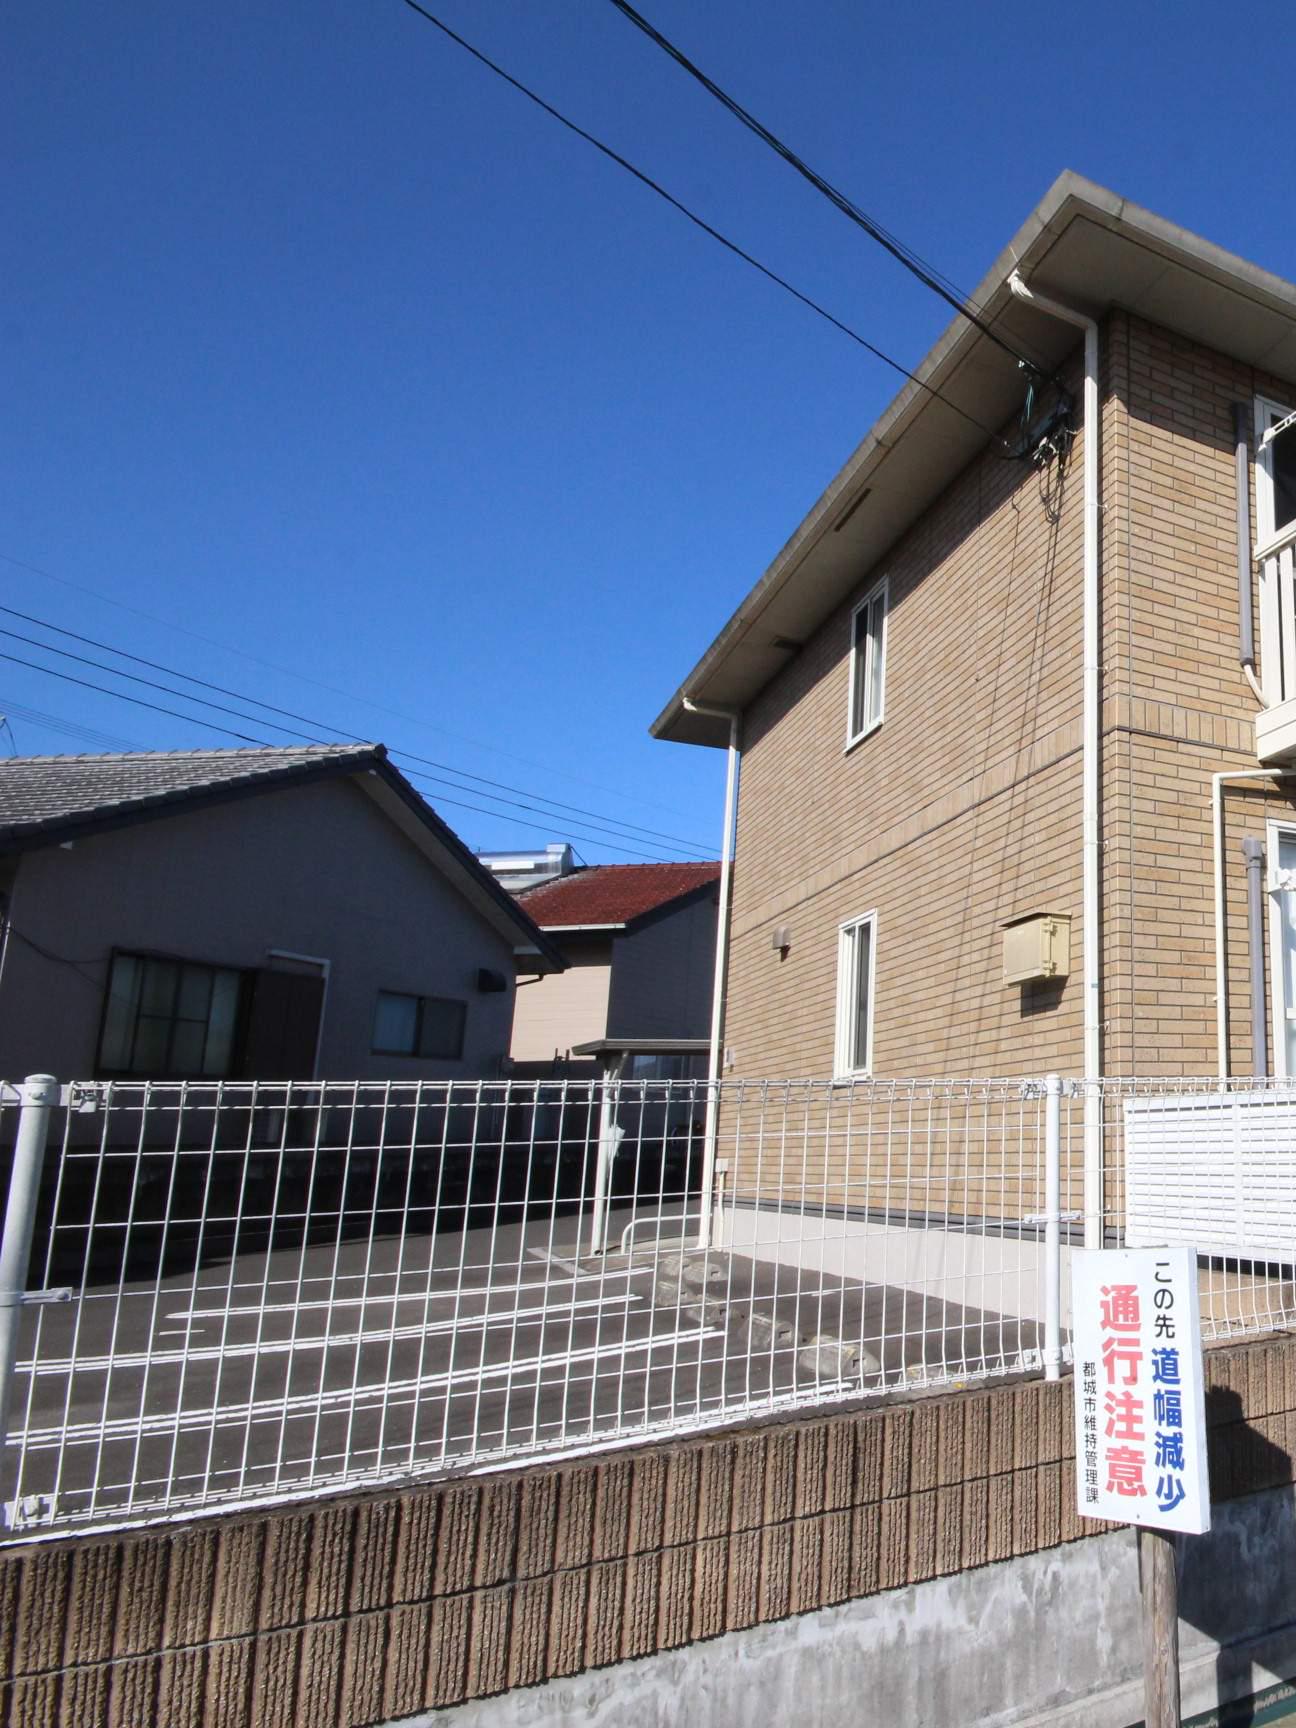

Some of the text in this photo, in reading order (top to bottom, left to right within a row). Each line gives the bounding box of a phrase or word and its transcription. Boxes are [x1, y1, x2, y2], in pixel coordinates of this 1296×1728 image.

[1082, 1361, 1099, 1504] 都城市維持管理課
[1099, 1284, 1147, 1498] 通行注意
